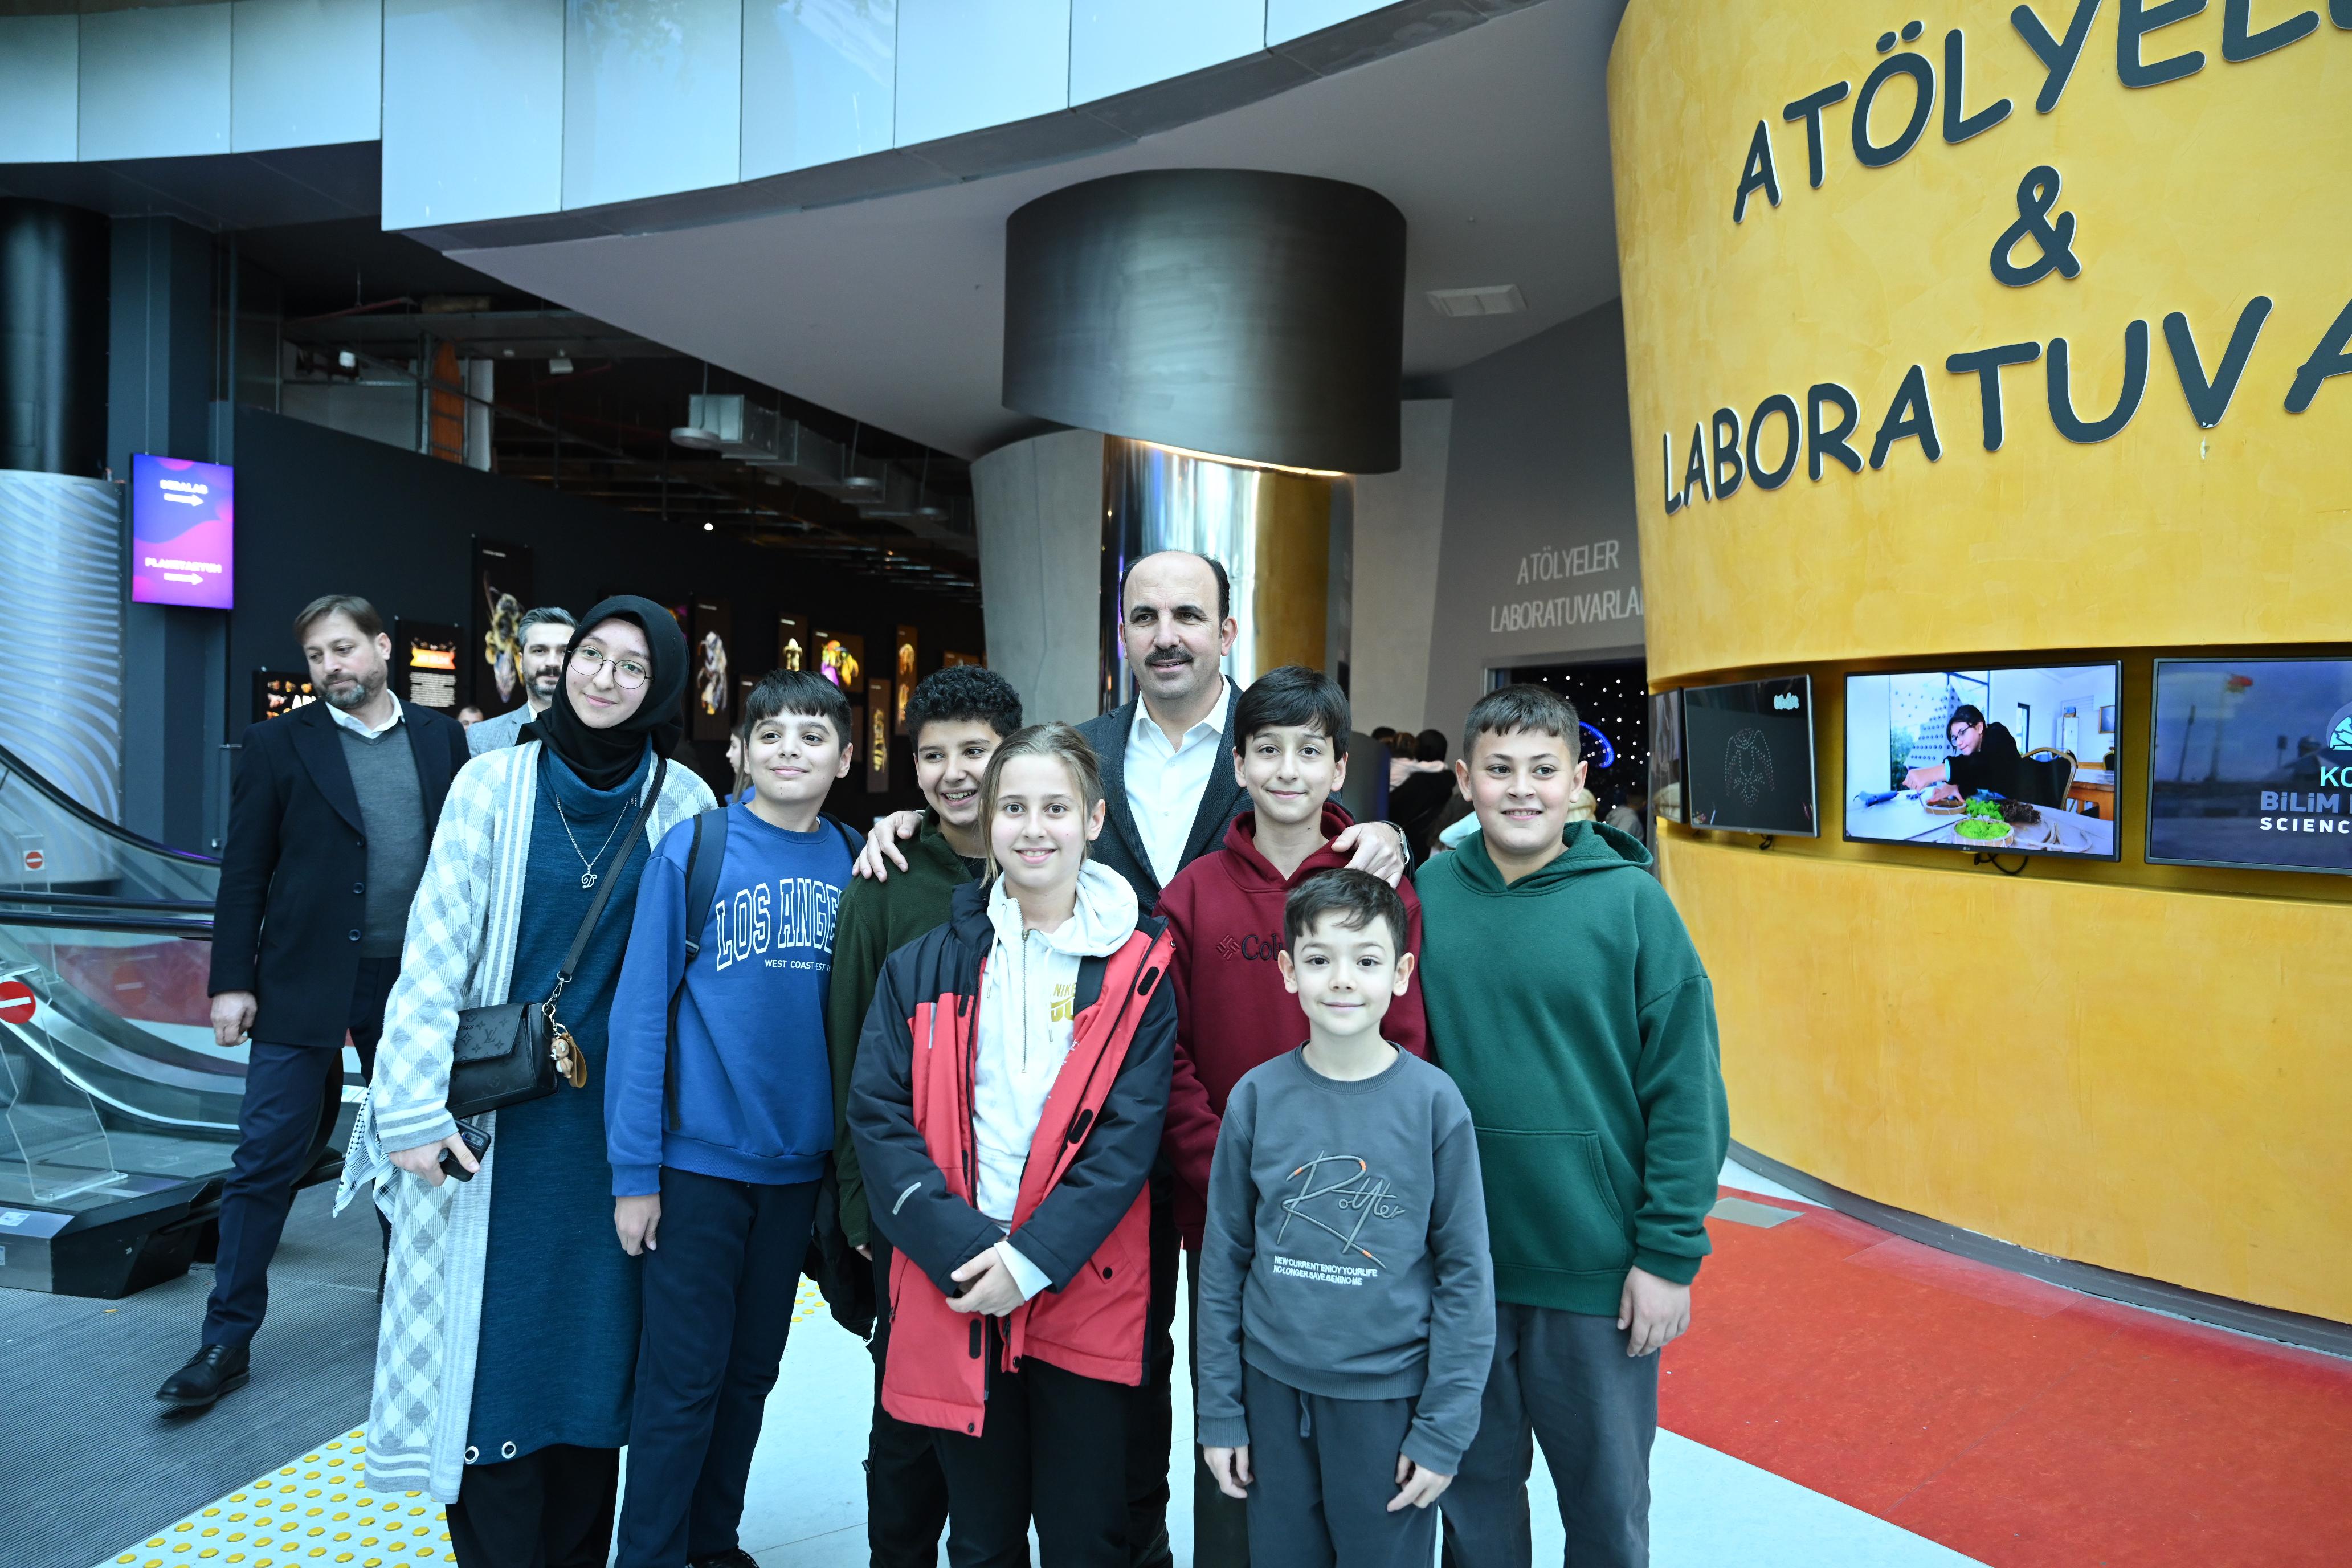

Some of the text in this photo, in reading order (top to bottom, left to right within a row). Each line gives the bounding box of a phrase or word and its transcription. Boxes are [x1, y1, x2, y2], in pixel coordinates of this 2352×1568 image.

[1733, 0, 2352, 224] ATÖLYEL
[1990, 165, 2082, 288] &
[1516, 540, 1619, 585] ATÖLYELER
[715, 877, 842, 971] LOS ANGE
[765, 959, 787, 968] WEST
[1241, 934, 1283, 961] Col
[1273, 1264, 1283, 1273] NO
[1282, 1266, 1309, 1278] LONGER
[1309, 1271, 1326, 1281] SAVE
[1352, 1276, 1363, 1286] ME
[1274, 1255, 1288, 1265] NEW
[1288, 1259, 1321, 1271] CURRENT
[1362, 1268, 1378, 1277] LIFE
